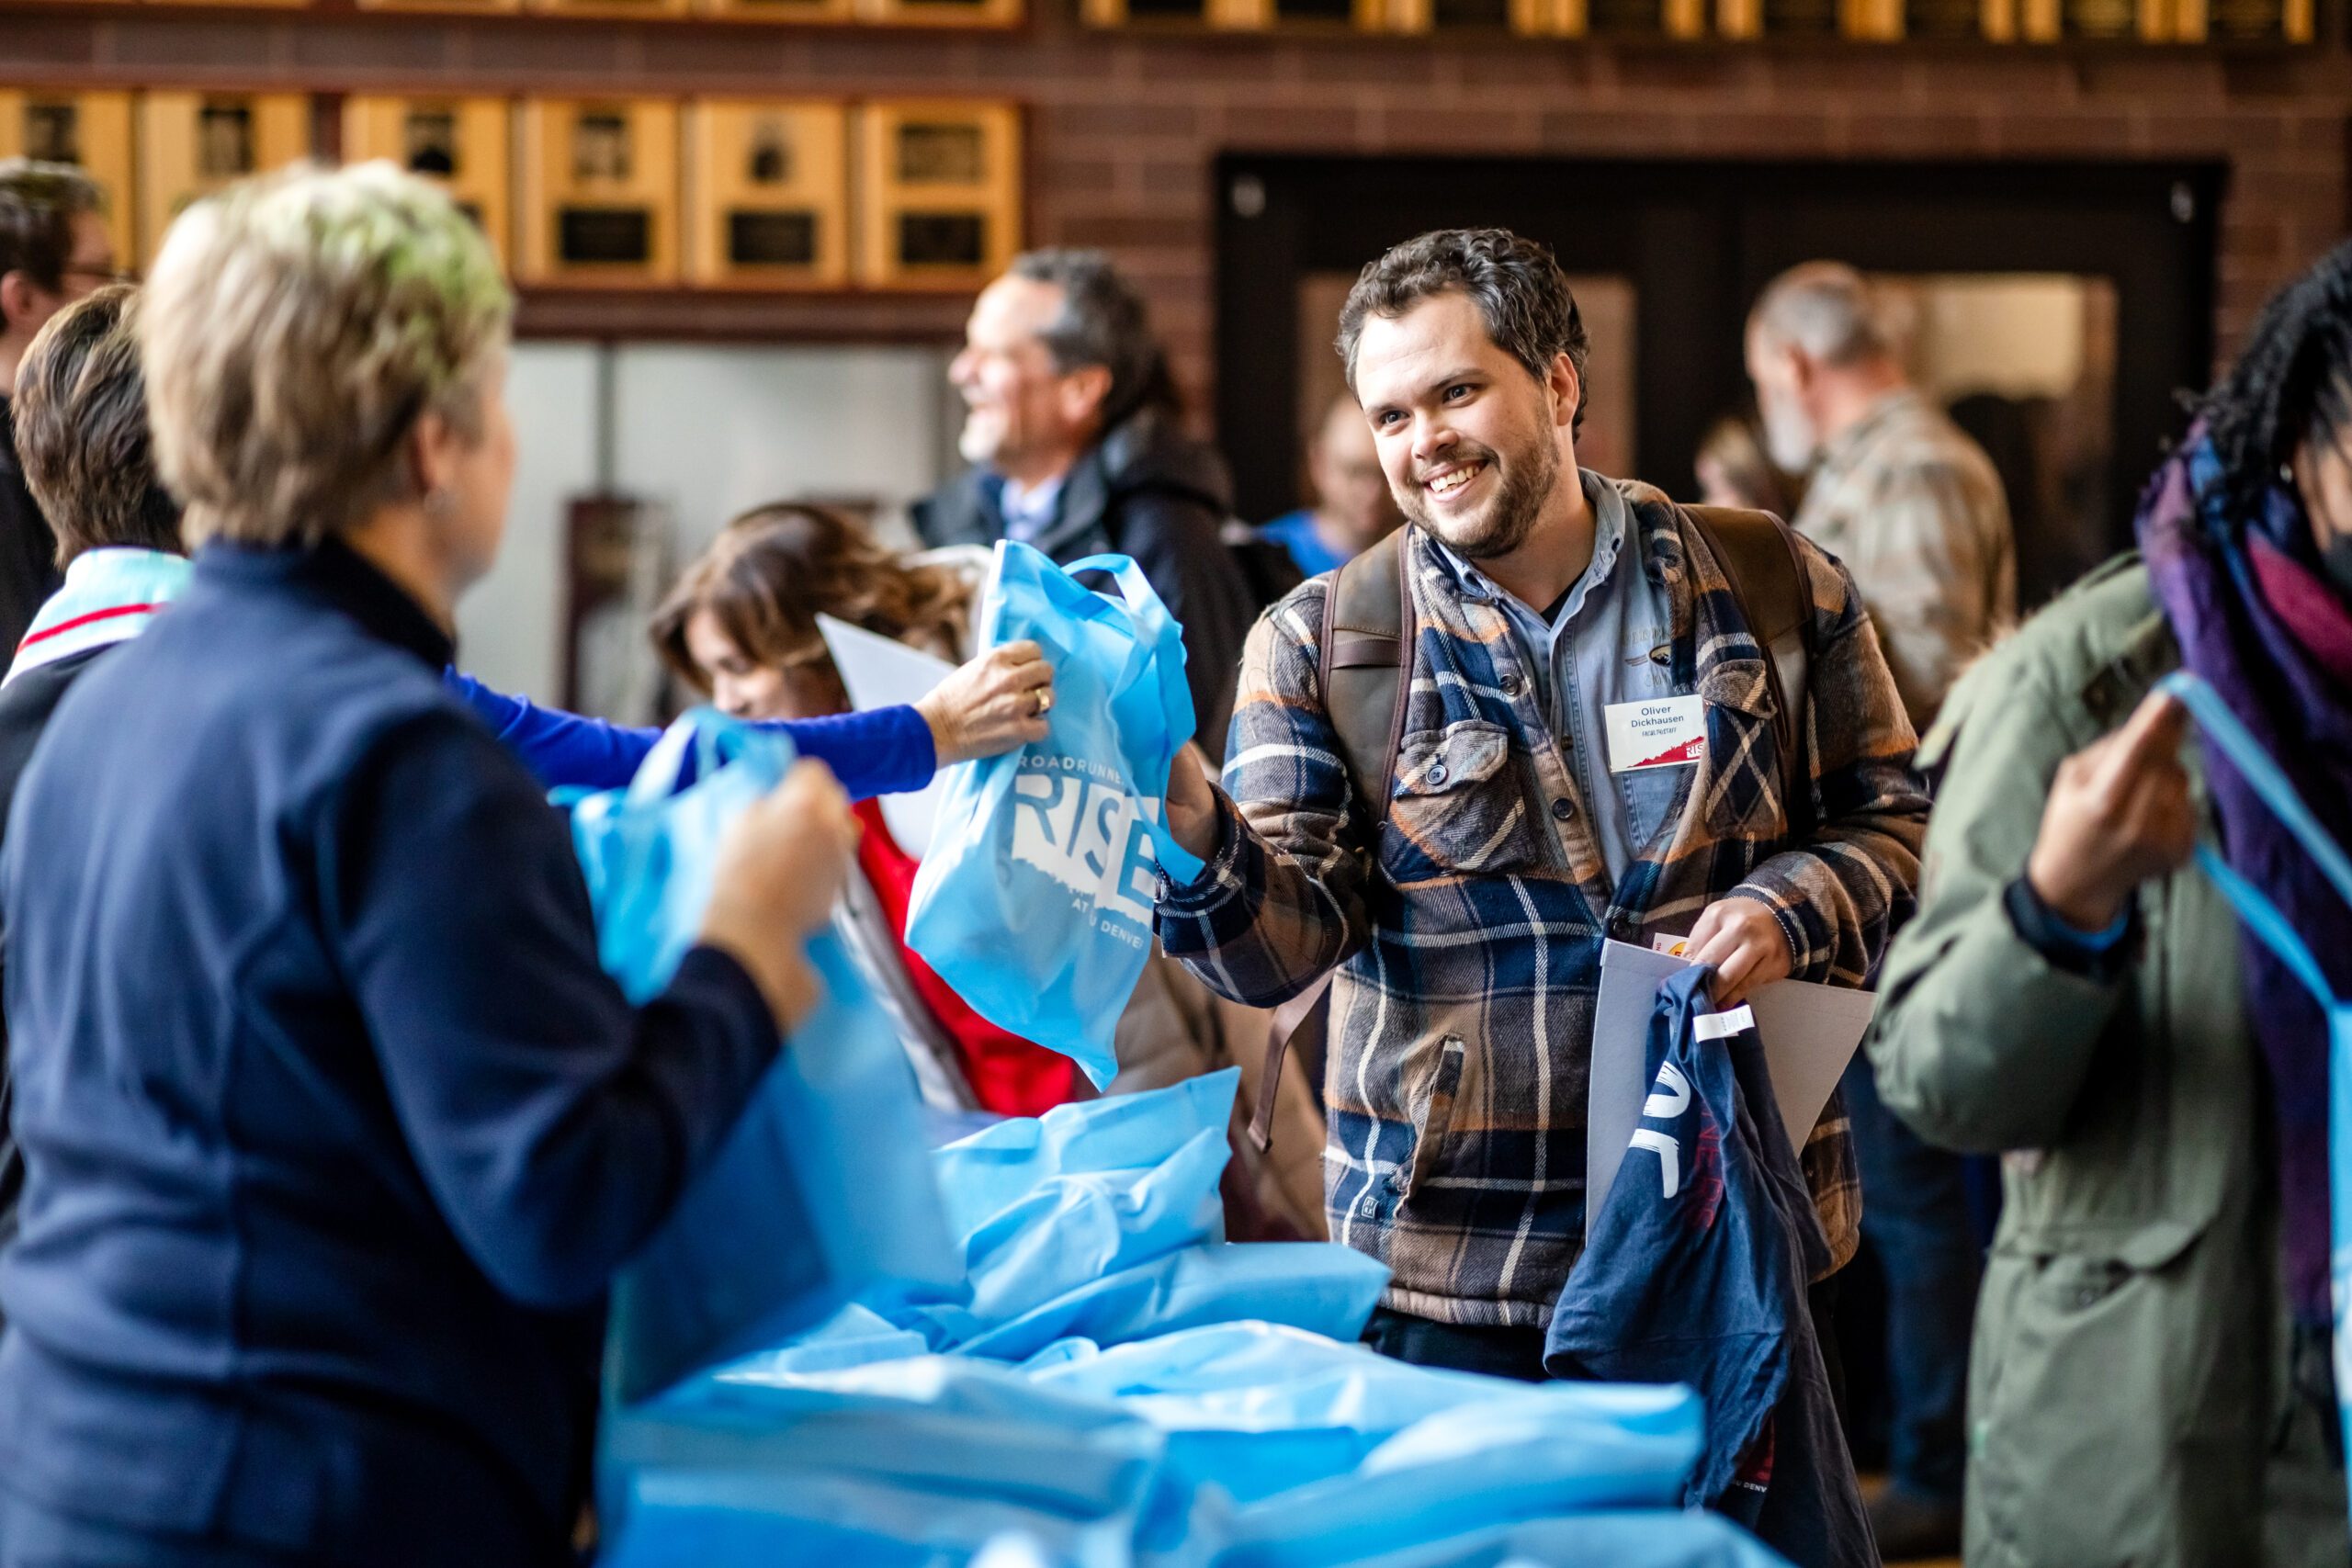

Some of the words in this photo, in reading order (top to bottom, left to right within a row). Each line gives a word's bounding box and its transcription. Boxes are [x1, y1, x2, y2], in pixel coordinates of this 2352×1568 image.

[1641, 705, 1672, 716] Oliver
[1631, 715, 1684, 728] Dickhausen
[1686, 742, 1704, 755] RIS
[1018, 754, 1124, 784] ROADRUNNE
[1013, 773, 1155, 909] RISE
[1072, 897, 1089, 914] AT
[1090, 915, 1097, 927] U
[1102, 921, 1144, 948] DENVE
[1744, 1482, 1768, 1493] DENV
